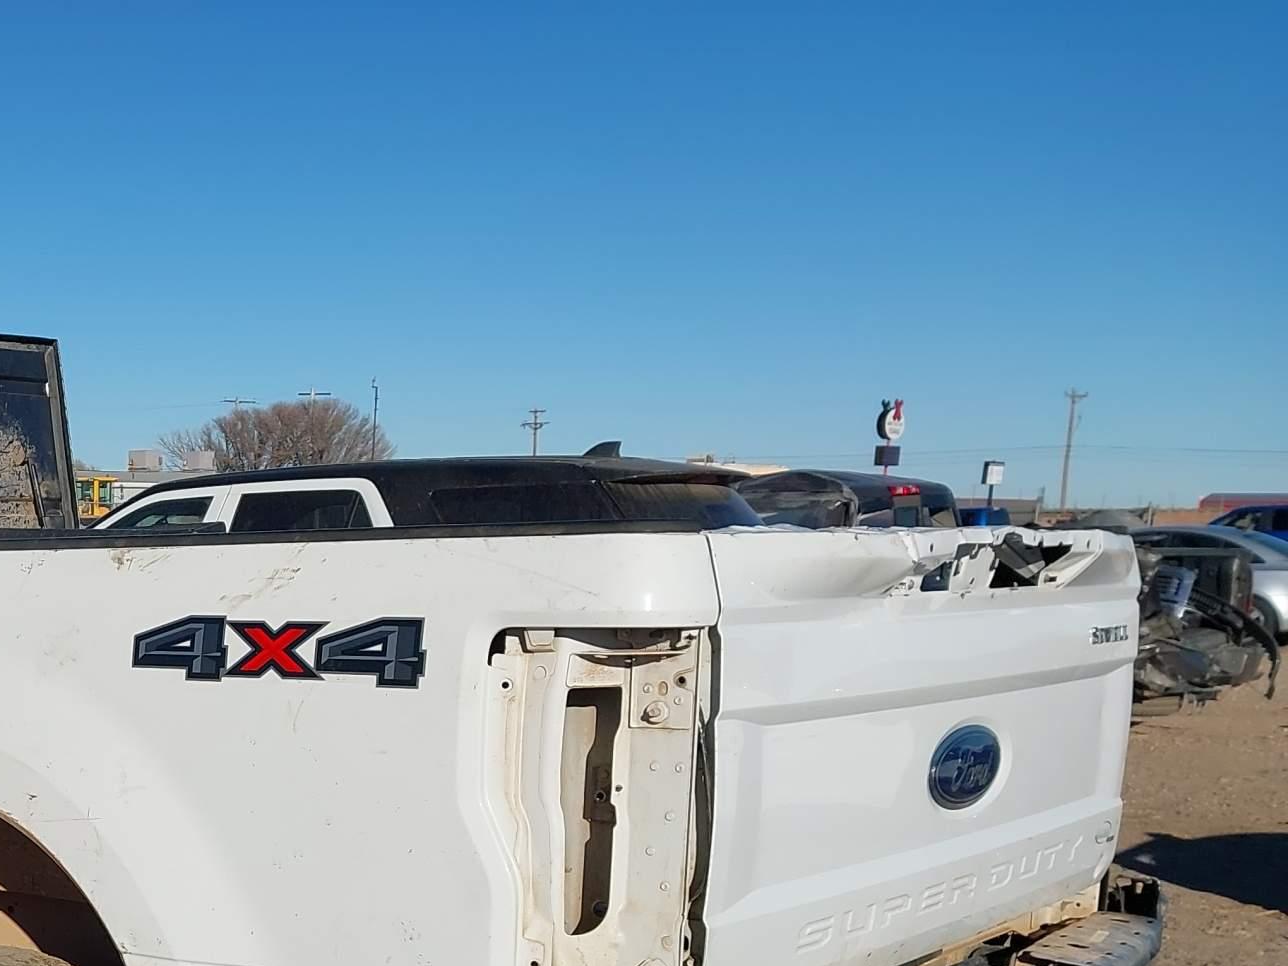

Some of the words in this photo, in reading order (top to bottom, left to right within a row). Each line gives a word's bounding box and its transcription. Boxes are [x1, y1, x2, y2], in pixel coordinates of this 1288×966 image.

[949, 747, 994, 792] Ford
[795, 874, 977, 953] SUPER
[988, 835, 1084, 892] DUTY
